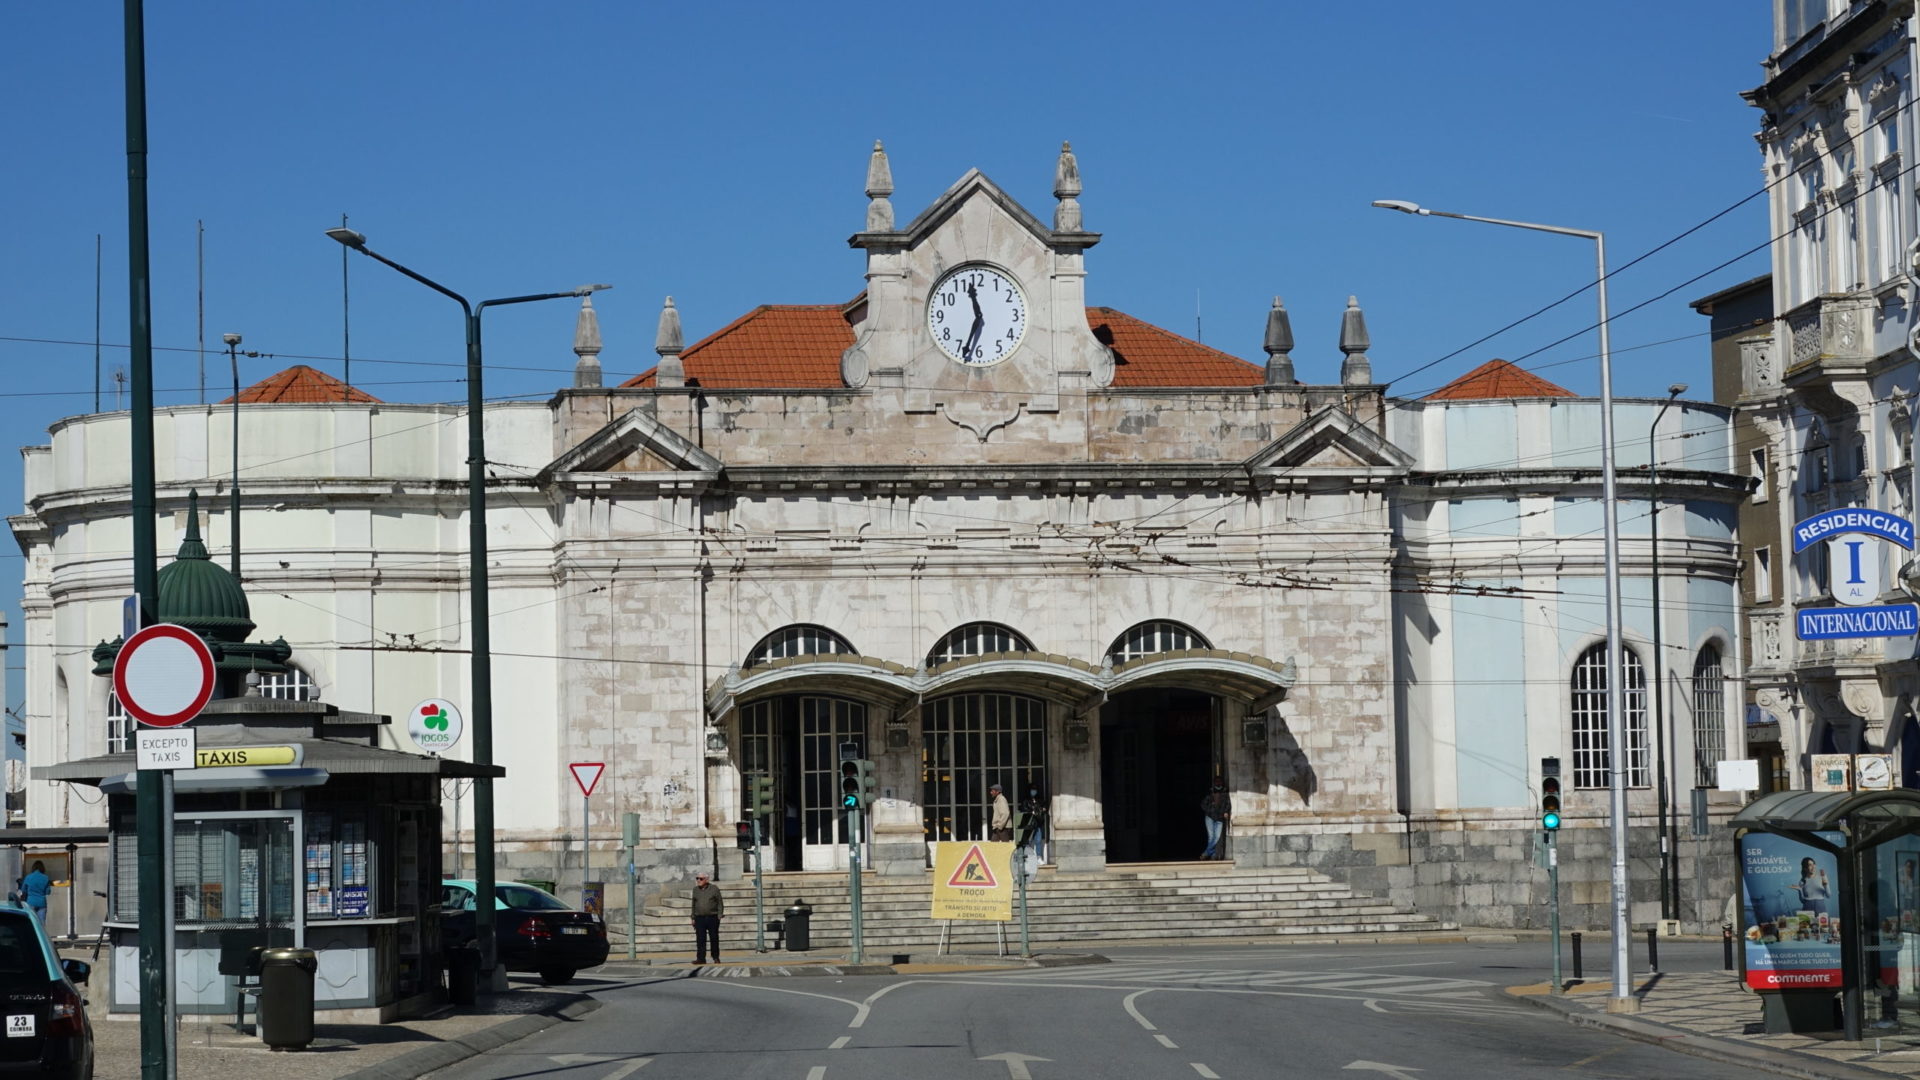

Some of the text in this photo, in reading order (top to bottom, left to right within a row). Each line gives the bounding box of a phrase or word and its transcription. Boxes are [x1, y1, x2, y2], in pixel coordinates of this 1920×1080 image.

[953, 279, 966, 292] 11
[970, 274, 984, 287] 12
[993, 279, 998, 291] 1
[941, 293, 955, 306] 10
[1005, 289, 1013, 303] 2
[936, 310, 944, 323] 9
[1012, 309, 1019, 322] 3
[943, 327, 950, 340] 8
[1006, 328, 1014, 341] 4
[955, 340, 963, 353] 7
[975, 345, 983, 358] 6
[995, 340, 1003, 353] 5
[1798, 513, 1910, 542] RESIDENCIAL
[1844, 542, 1866, 584] I
[1849, 588, 1863, 597] AL
[1802, 610, 1915, 635] INTERNACIONAL
[142, 738, 188, 749] EXCEPTO
[421, 734, 449, 745] JOGOS
[199, 750, 247, 766] TÁXIS
[1746, 848, 1762, 856] SER
[1747, 855, 1789, 865] SAUDÁVEL
[1747, 866, 1792, 874] E GULOSA?
[960, 889, 985, 897] TROÇO
[1767, 974, 1830, 983] CONTINENTE
[14, 1016, 27, 1026] 23
